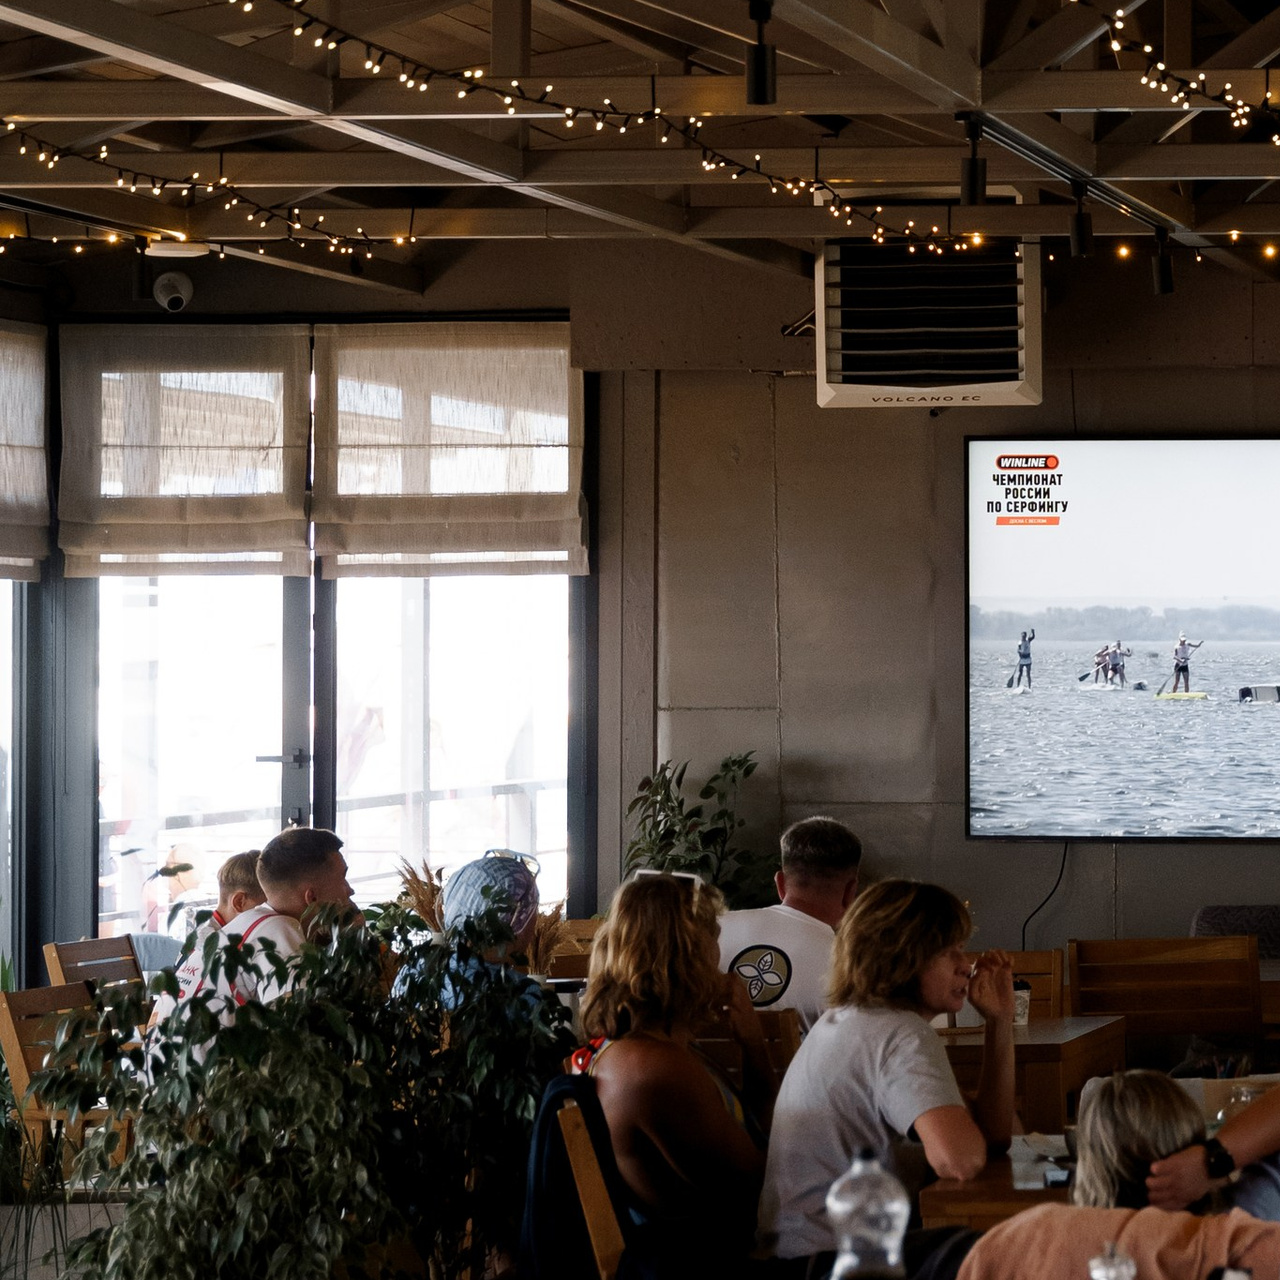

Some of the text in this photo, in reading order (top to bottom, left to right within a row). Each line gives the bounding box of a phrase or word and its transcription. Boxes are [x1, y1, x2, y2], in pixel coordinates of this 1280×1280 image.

[1000, 457, 1046, 468] WINLINE
[992, 473, 1063, 486] ЧЕМПИОНАТ
[1004, 487, 1051, 499] РОССИИ
[986, 500, 1068, 513] ПО СЕРФИНГУ
